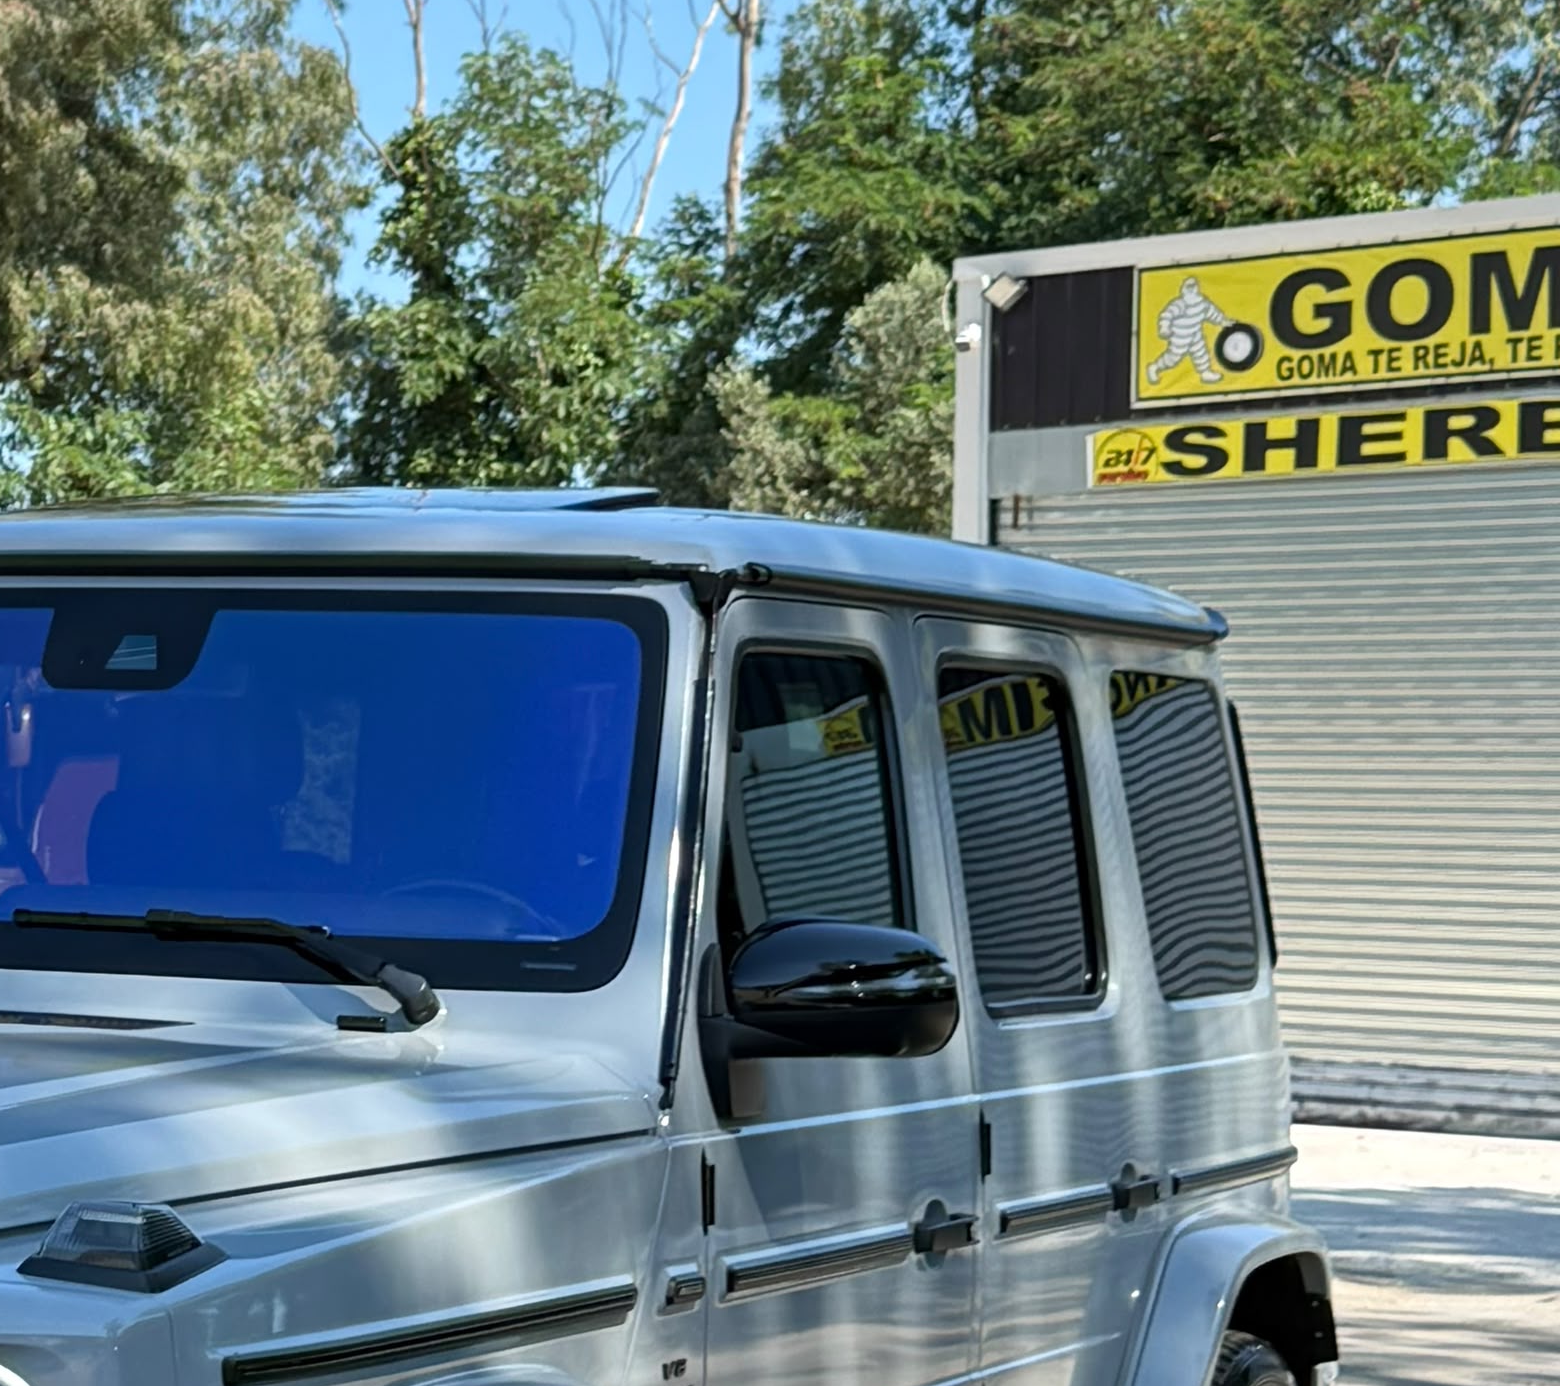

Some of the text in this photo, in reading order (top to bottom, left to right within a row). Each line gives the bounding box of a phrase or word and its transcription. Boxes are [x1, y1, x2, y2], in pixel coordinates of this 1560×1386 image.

[1269, 245, 1560, 351] GOM
[1276, 349, 1356, 382] GOMA
[1368, 345, 1403, 374] TE
[1413, 338, 1495, 371] REJA,
[1506, 335, 1544, 364] TE
